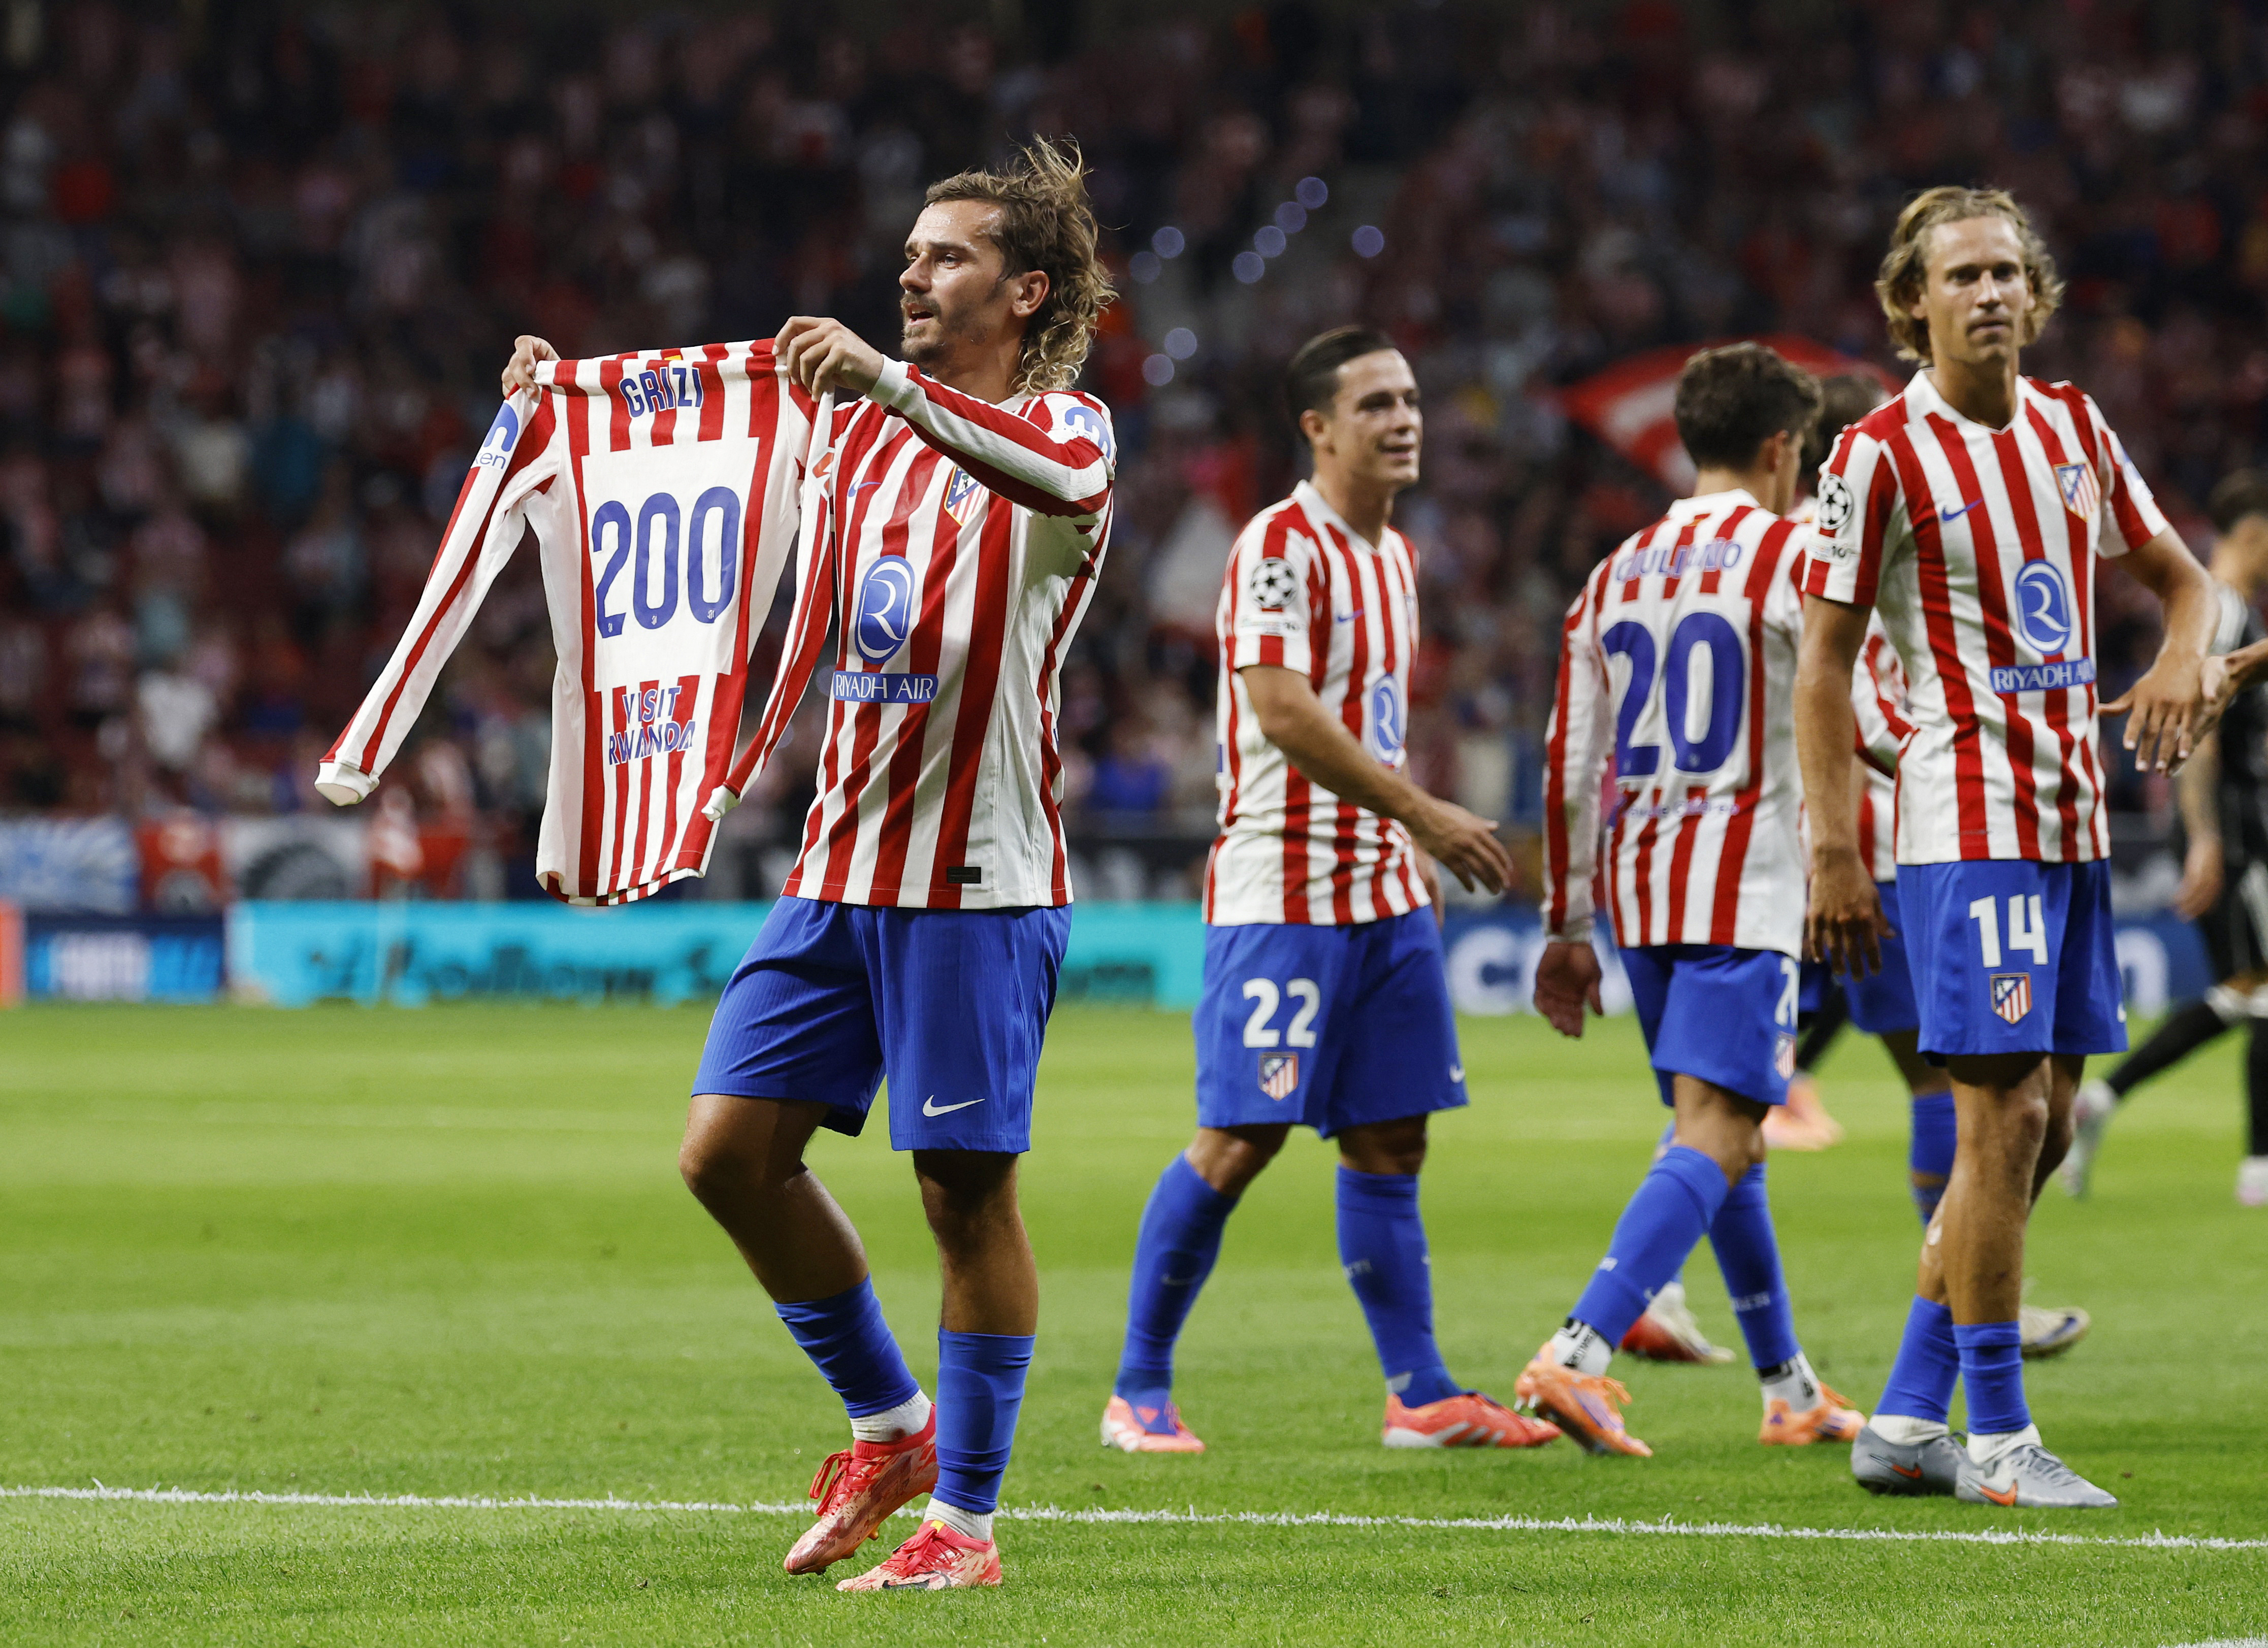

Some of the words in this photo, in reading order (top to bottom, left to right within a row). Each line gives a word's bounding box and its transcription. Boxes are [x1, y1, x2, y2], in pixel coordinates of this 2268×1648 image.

[619, 366, 704, 418] GRIZI
[591, 485, 740, 639] 200
[835, 674, 888, 699] RIYADH
[896, 677, 933, 700] AIR
[1602, 612, 1745, 777] 20
[1993, 662, 2073, 691] RIYADH
[623, 685, 682, 724] VISIT
[609, 719, 696, 766] RWANDA
[1969, 893, 2049, 968] 14
[1242, 977, 1321, 1049] 22
